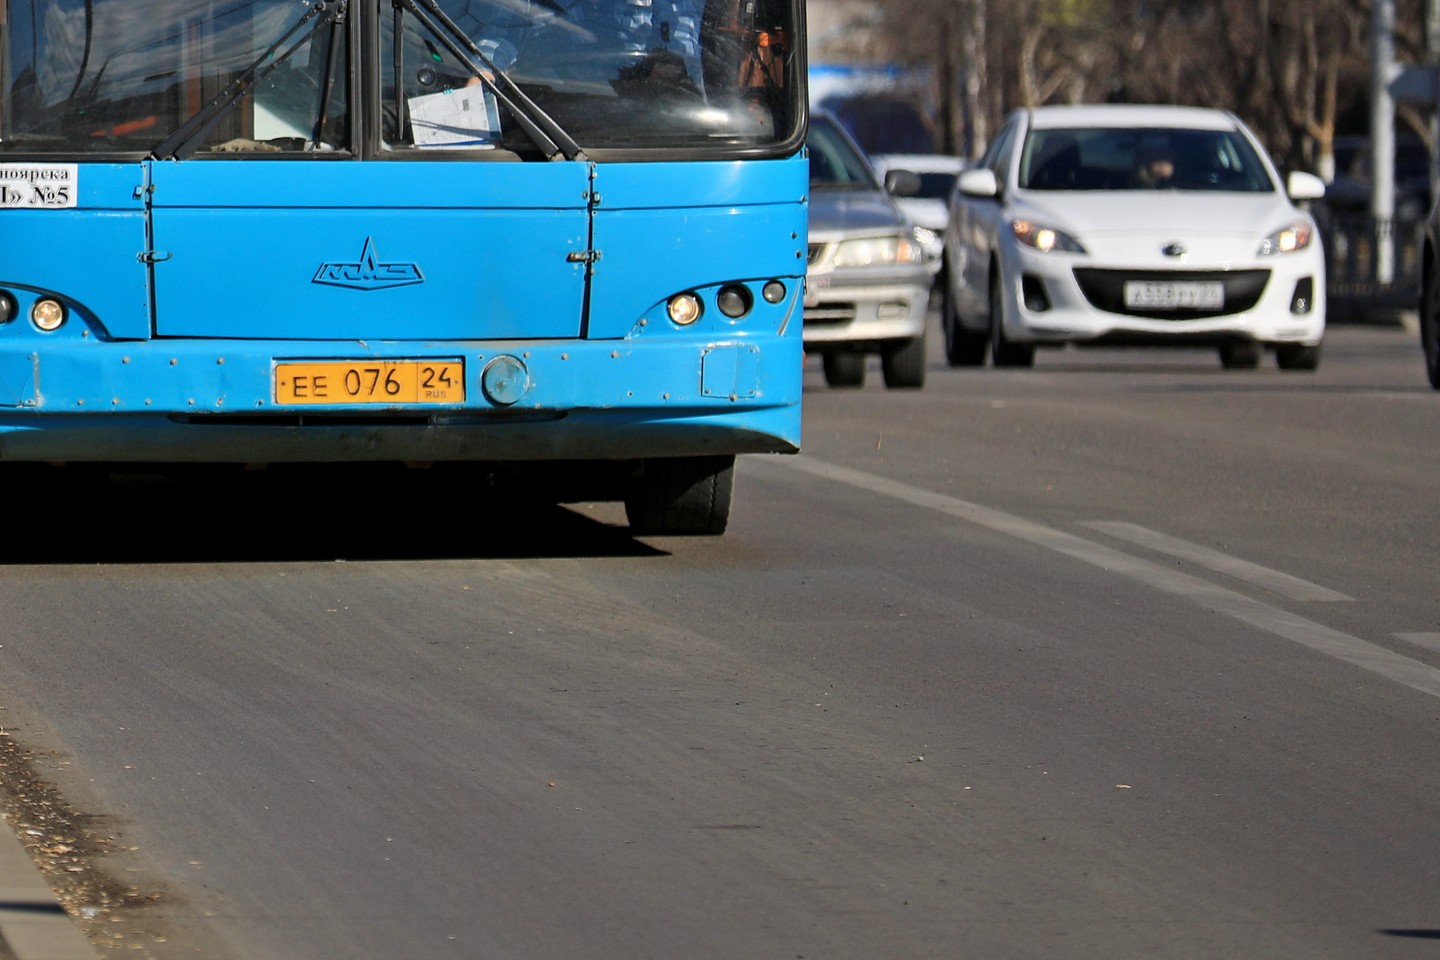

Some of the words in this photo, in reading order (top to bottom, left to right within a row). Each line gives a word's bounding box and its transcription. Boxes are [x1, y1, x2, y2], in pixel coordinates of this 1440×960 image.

[29, 186, 69, 206] №5
[292, 376, 328, 397] ЕЕ
[344, 368, 401, 396] 076
[422, 366, 452, 388] 24
[425, 390, 448, 399] RUS
